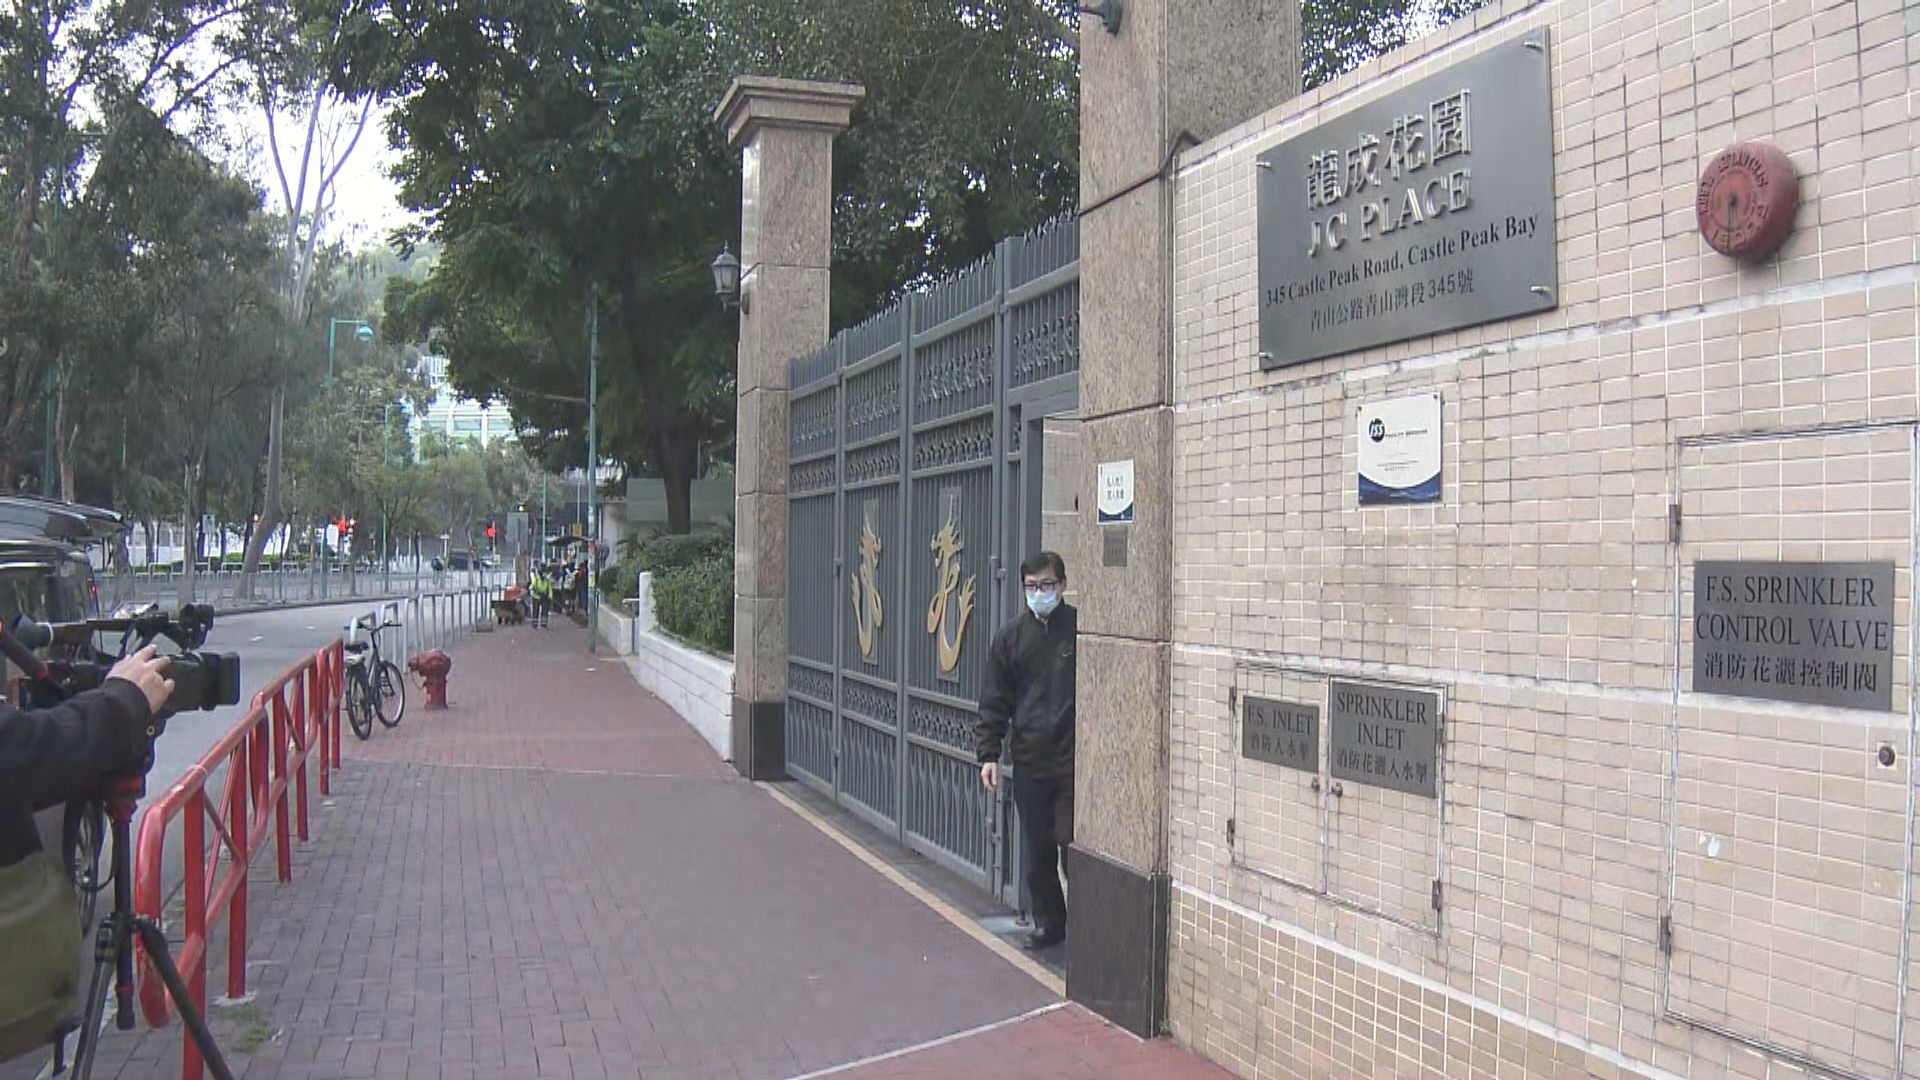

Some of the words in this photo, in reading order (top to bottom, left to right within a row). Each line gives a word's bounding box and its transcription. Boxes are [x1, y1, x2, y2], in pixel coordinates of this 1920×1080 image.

[1306, 88, 1472, 211] 龍成花園
[1308, 212, 1347, 258] JC
[1361, 168, 1472, 242] PLACE
[1266, 285, 1285, 307] 345
[1287, 275, 1325, 301] Castle
[1328, 263, 1359, 289] Peak
[1363, 250, 1404, 279] Road,
[1408, 236, 1455, 266] Castle
[1460, 222, 1500, 252] Peak
[1505, 213, 1538, 240] Bay
[1706, 575, 1737, 604] F.S.
[1744, 575, 1878, 608] SPRINKLER
[1696, 613, 1800, 646] CONTROL
[1808, 617, 1889, 652] VALVE
[1704, 651, 1878, 693] 消防花灑控制閥
[1272, 708, 1314, 736] INLET
[1336, 691, 1427, 726] SPRINKLER
[1357, 722, 1406, 752] INLET
